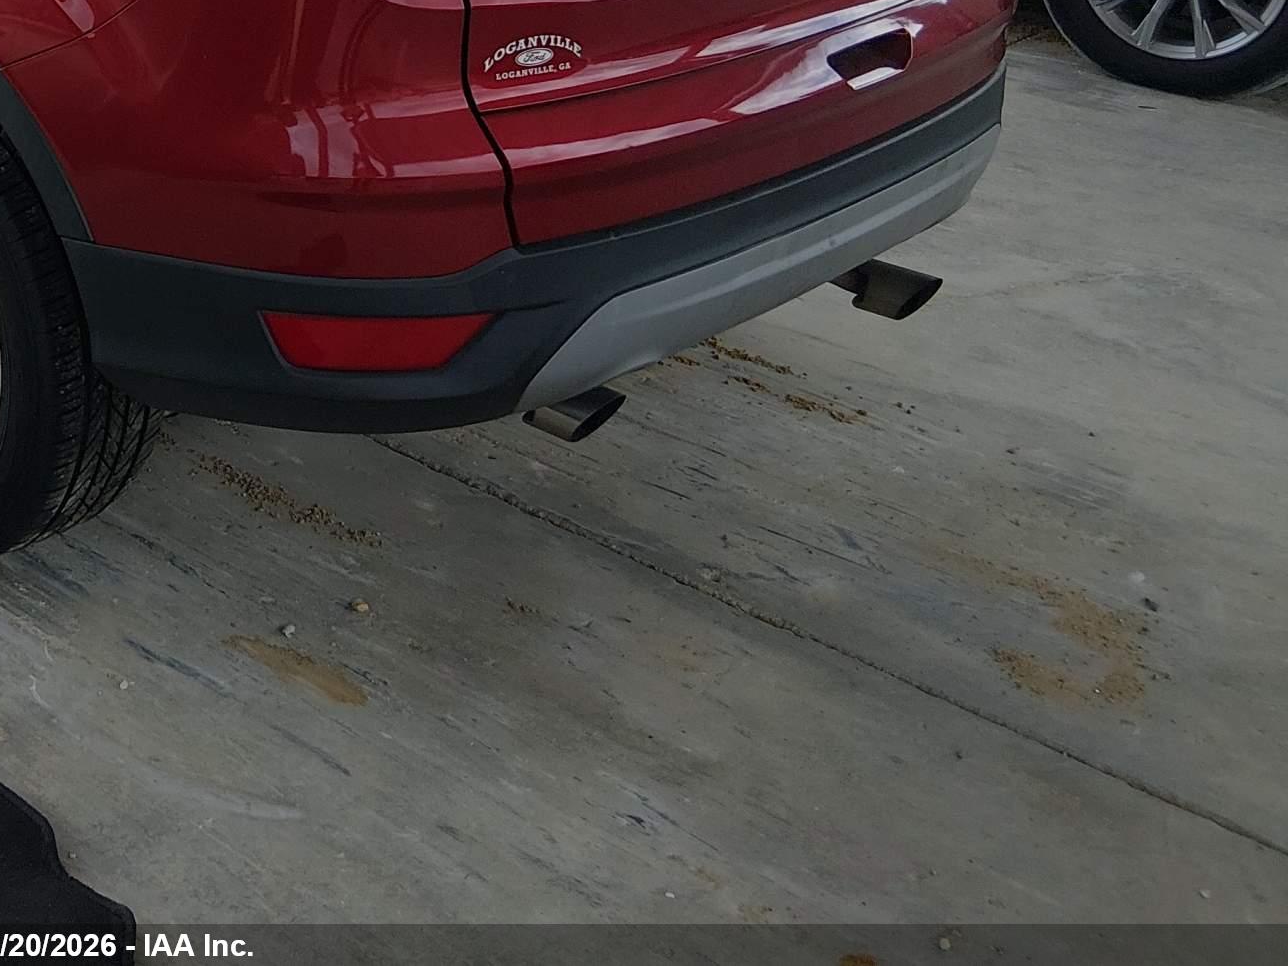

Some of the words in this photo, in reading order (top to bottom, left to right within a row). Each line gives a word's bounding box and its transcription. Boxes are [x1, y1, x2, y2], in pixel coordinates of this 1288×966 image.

[484, 35, 582, 72] LOGANVILLE
[496, 65, 557, 80] LOGANVILLE,
[558, 62, 571, 70] GA
